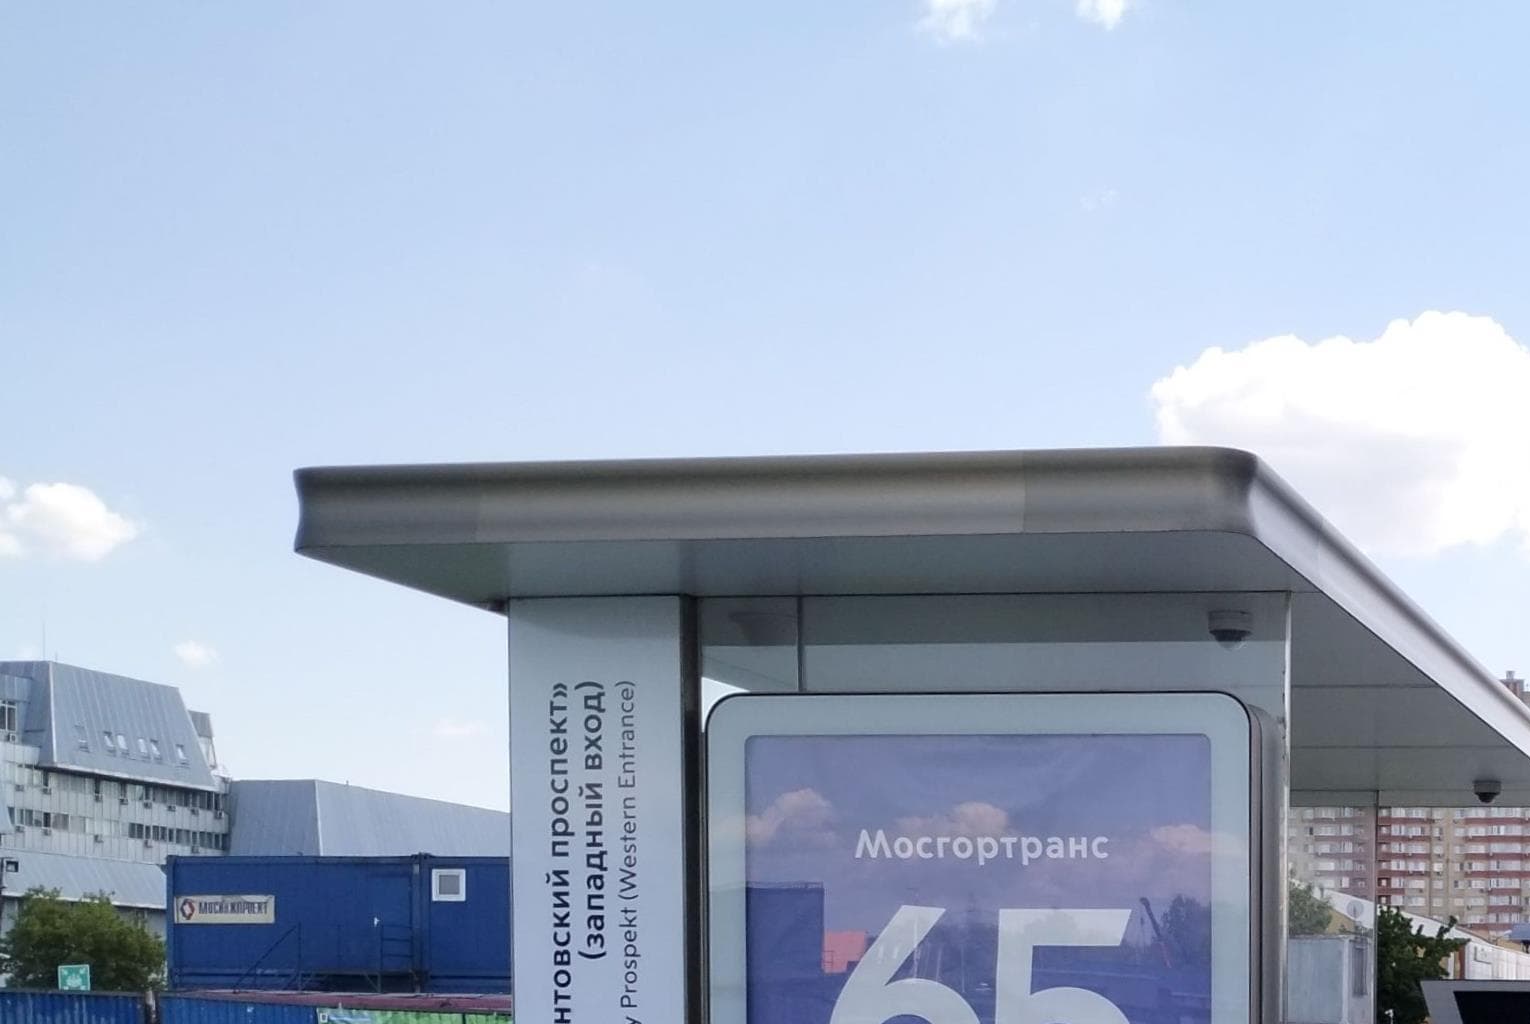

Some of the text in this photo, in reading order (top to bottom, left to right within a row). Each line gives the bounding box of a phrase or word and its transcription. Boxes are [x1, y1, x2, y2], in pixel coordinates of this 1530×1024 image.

[550, 681, 576, 858] проспект»
[614, 680, 637, 789] Entrance)
[574, 681, 608, 960] (западный вход)
[617, 797, 639, 901] (Western
[855, 829, 1109, 865] Мосгортранс
[618, 906, 641, 1009] Prospekt
